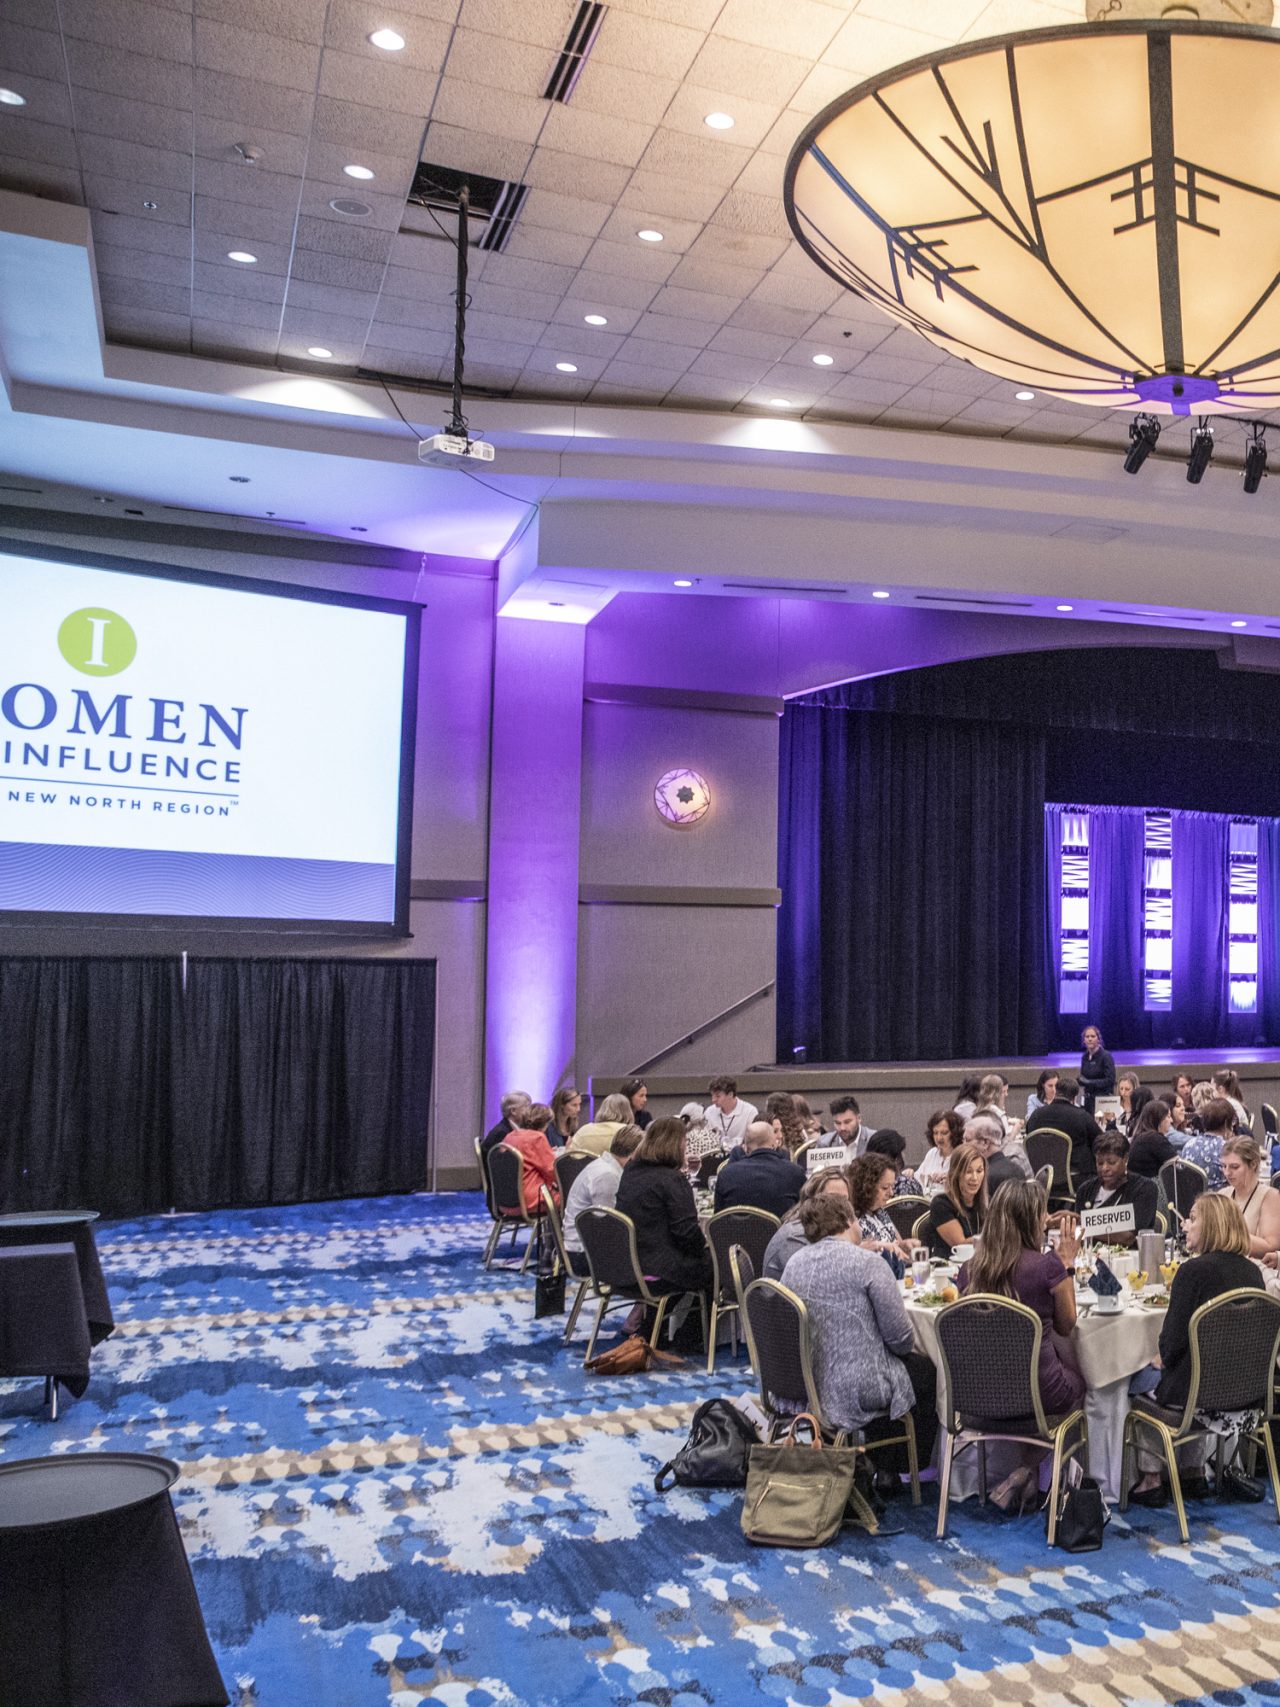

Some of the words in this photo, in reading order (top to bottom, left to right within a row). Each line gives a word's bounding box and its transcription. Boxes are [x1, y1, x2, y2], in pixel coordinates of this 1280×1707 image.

[84, 617, 112, 668] I
[0, 682, 249, 751] OMEN
[4, 741, 241, 783] INFLUENCE
[8, 791, 57, 806] NEW
[70, 795, 142, 811] NORTH
[810, 1150, 845, 1161] RESERVED
[1085, 1210, 1132, 1227] RESERVED
